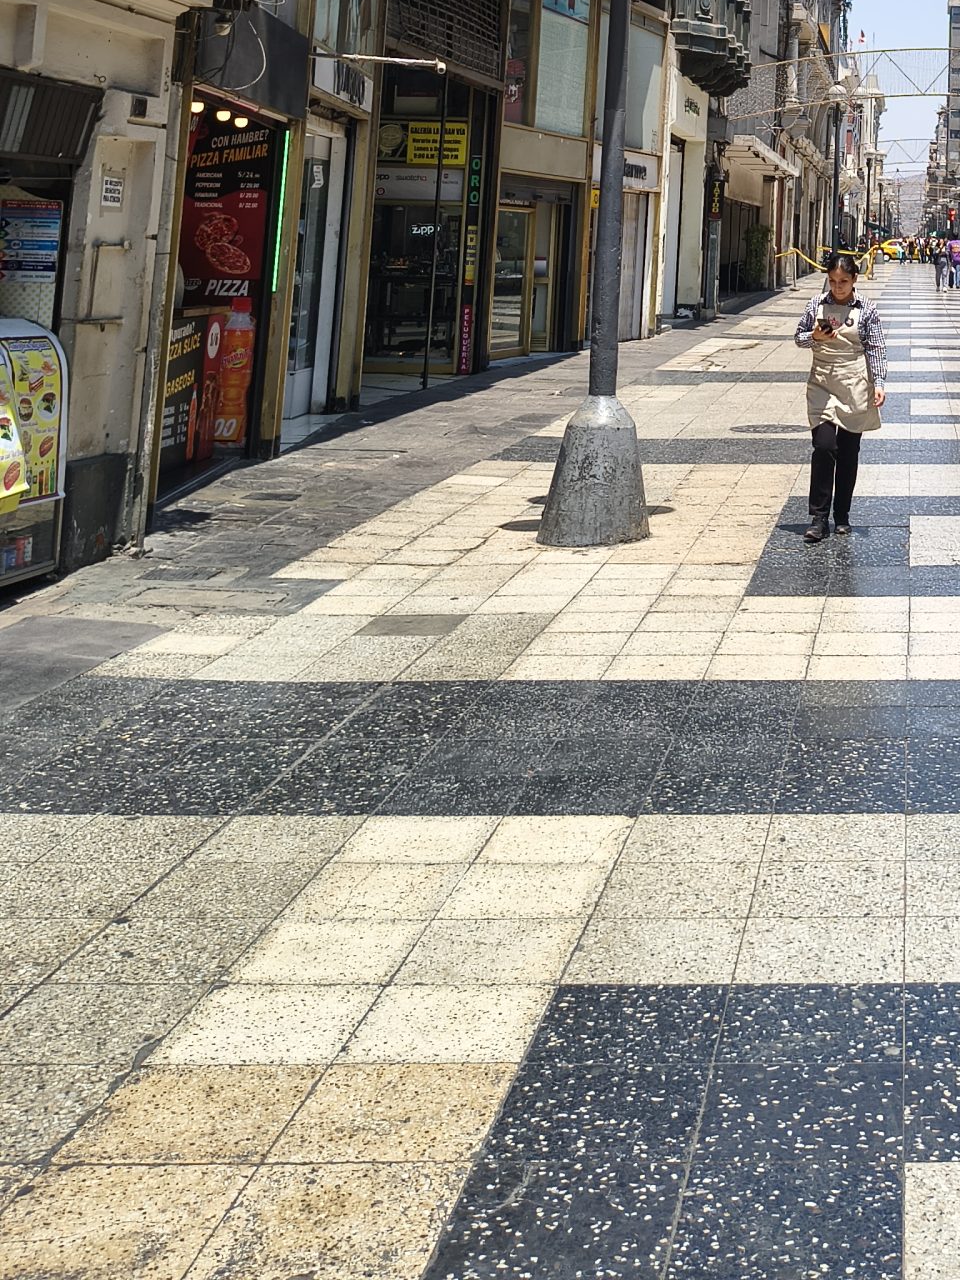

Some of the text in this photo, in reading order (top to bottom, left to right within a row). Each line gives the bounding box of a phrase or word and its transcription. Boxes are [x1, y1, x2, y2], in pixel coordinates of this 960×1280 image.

[211, 129, 270, 149] CON HAMBRE?
[190, 144, 268, 169] PIZZA FAMILIAR
[470, 159, 481, 203] ORO
[712, 181, 721, 214] TATTOO
[204, 279, 250, 297] PIZZA
[461, 308, 470, 370] PELUQUERIA
